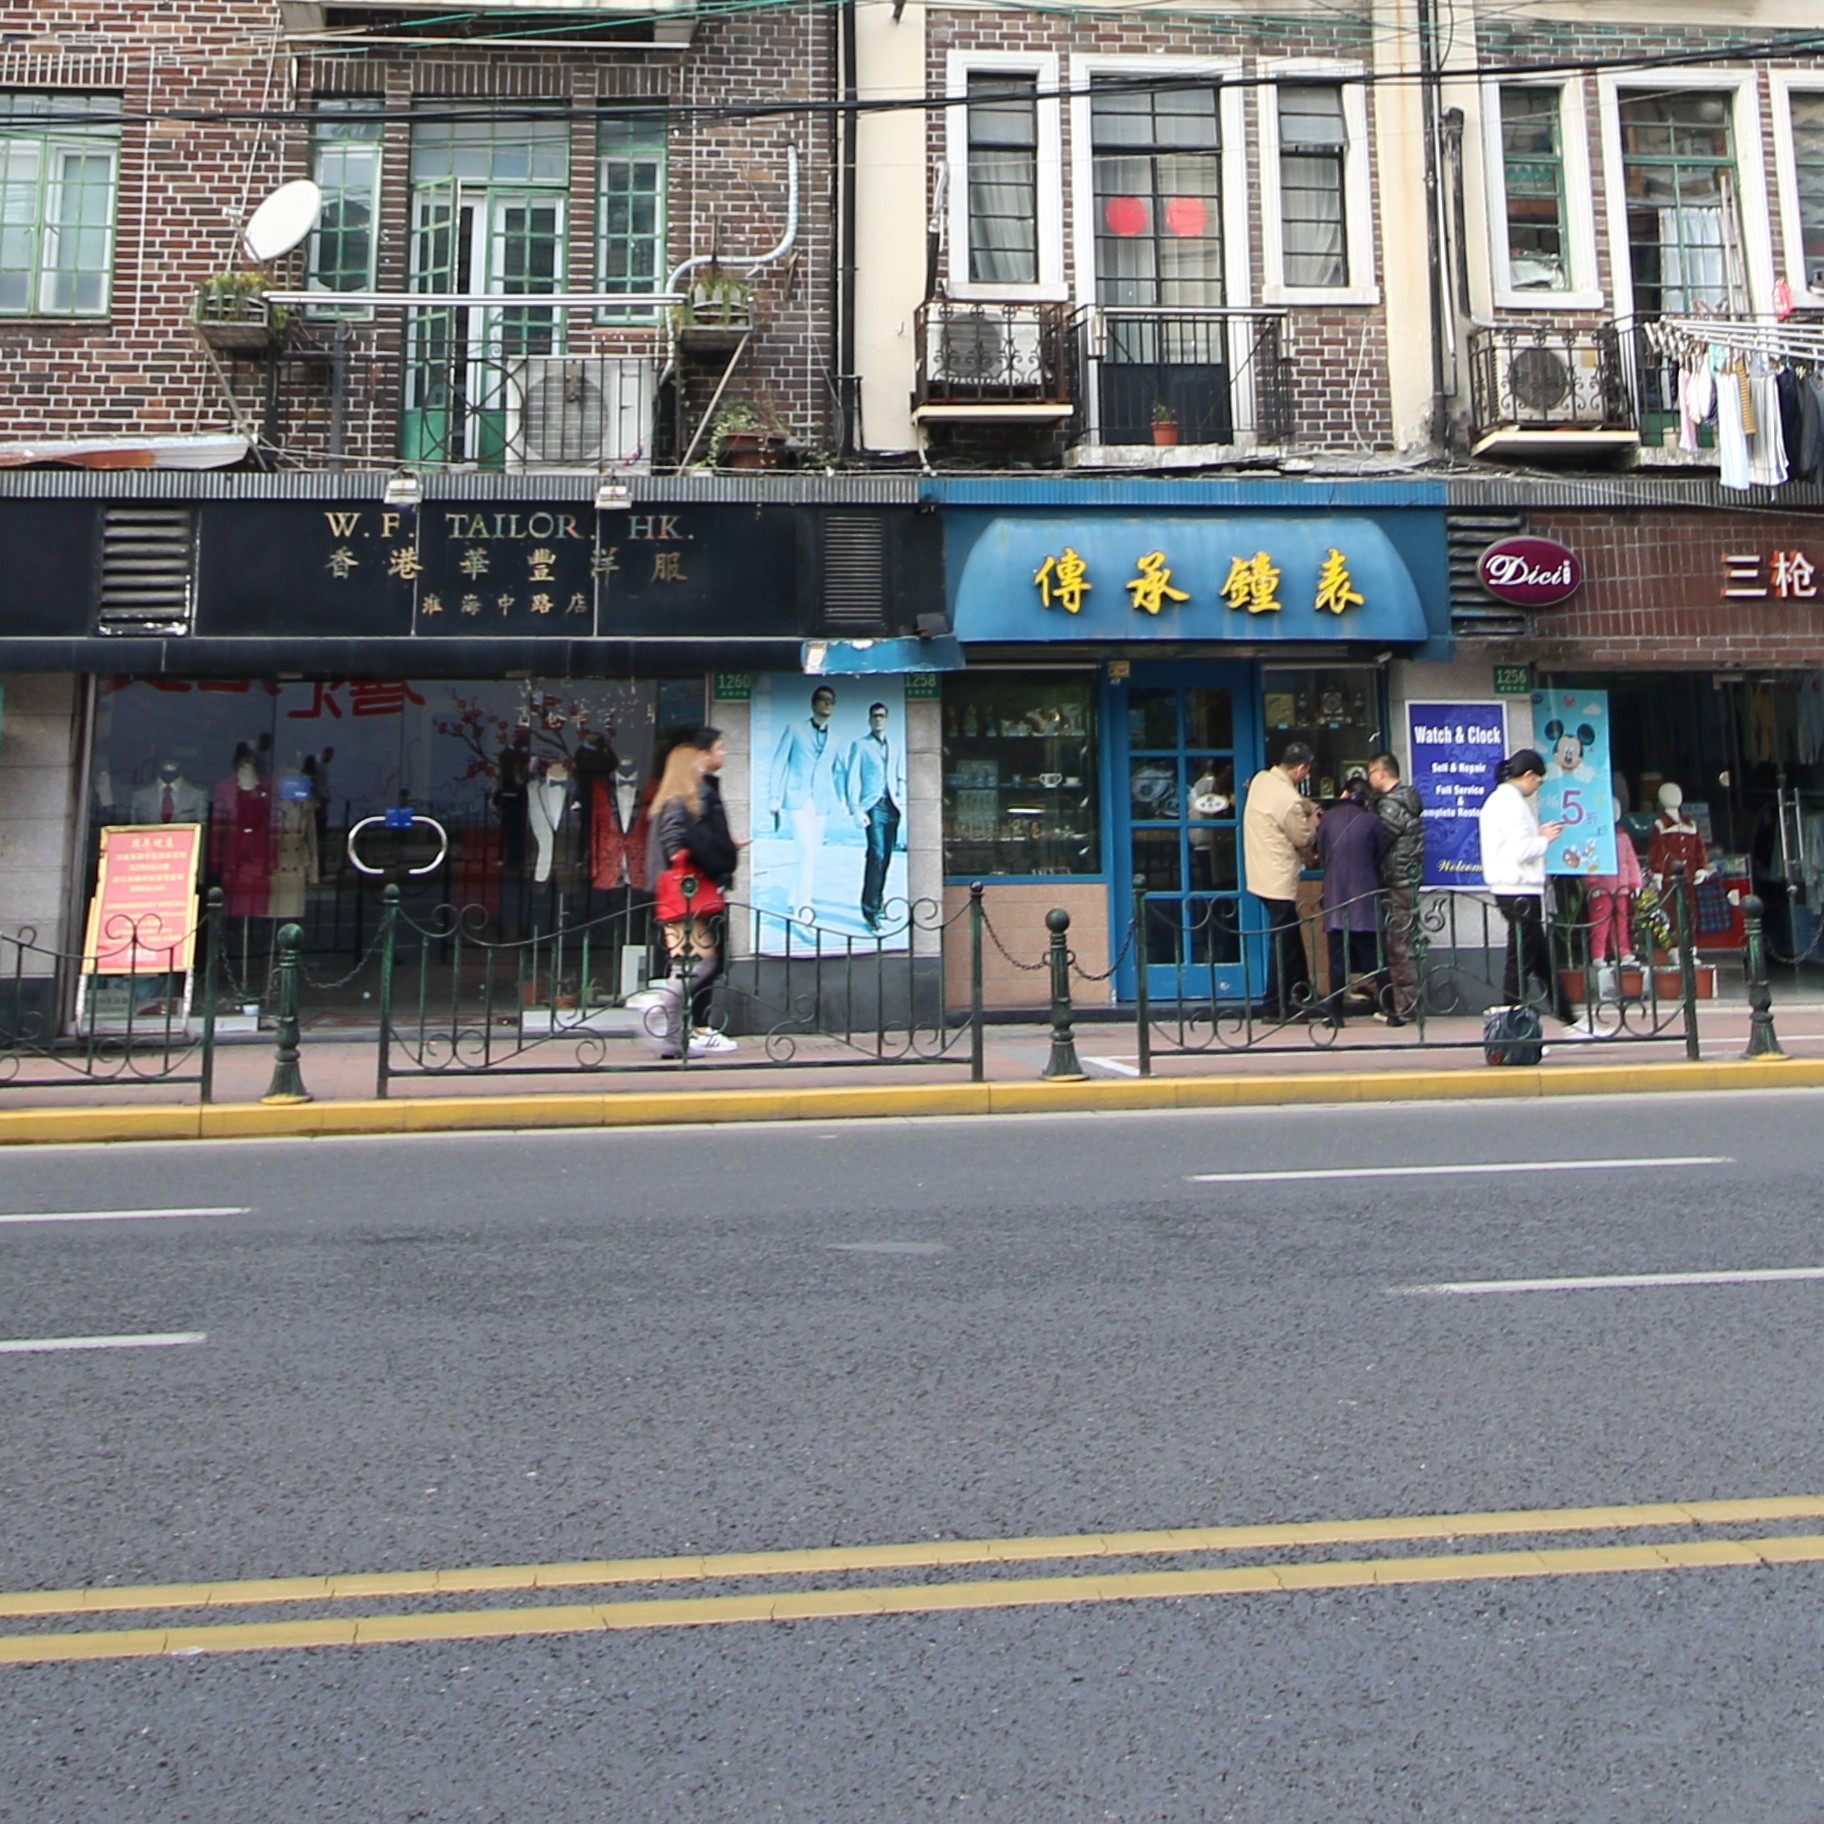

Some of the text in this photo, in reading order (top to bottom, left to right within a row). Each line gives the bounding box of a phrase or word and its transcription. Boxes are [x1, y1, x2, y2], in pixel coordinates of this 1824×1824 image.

[325, 546, 688, 582] 香港華豐洋服
[422, 592, 588, 617] 淮海中路店
[905, 673, 937, 688] 1258
[1497, 669, 1527, 684] 1256
[1414, 726, 1501, 744] Watch & Clock
[1450, 762, 1457, 773] &
[1459, 762, 1486, 776] Repair
[1436, 784, 1484, 795] Full Service
[1437, 859, 1483, 872] Welcom
